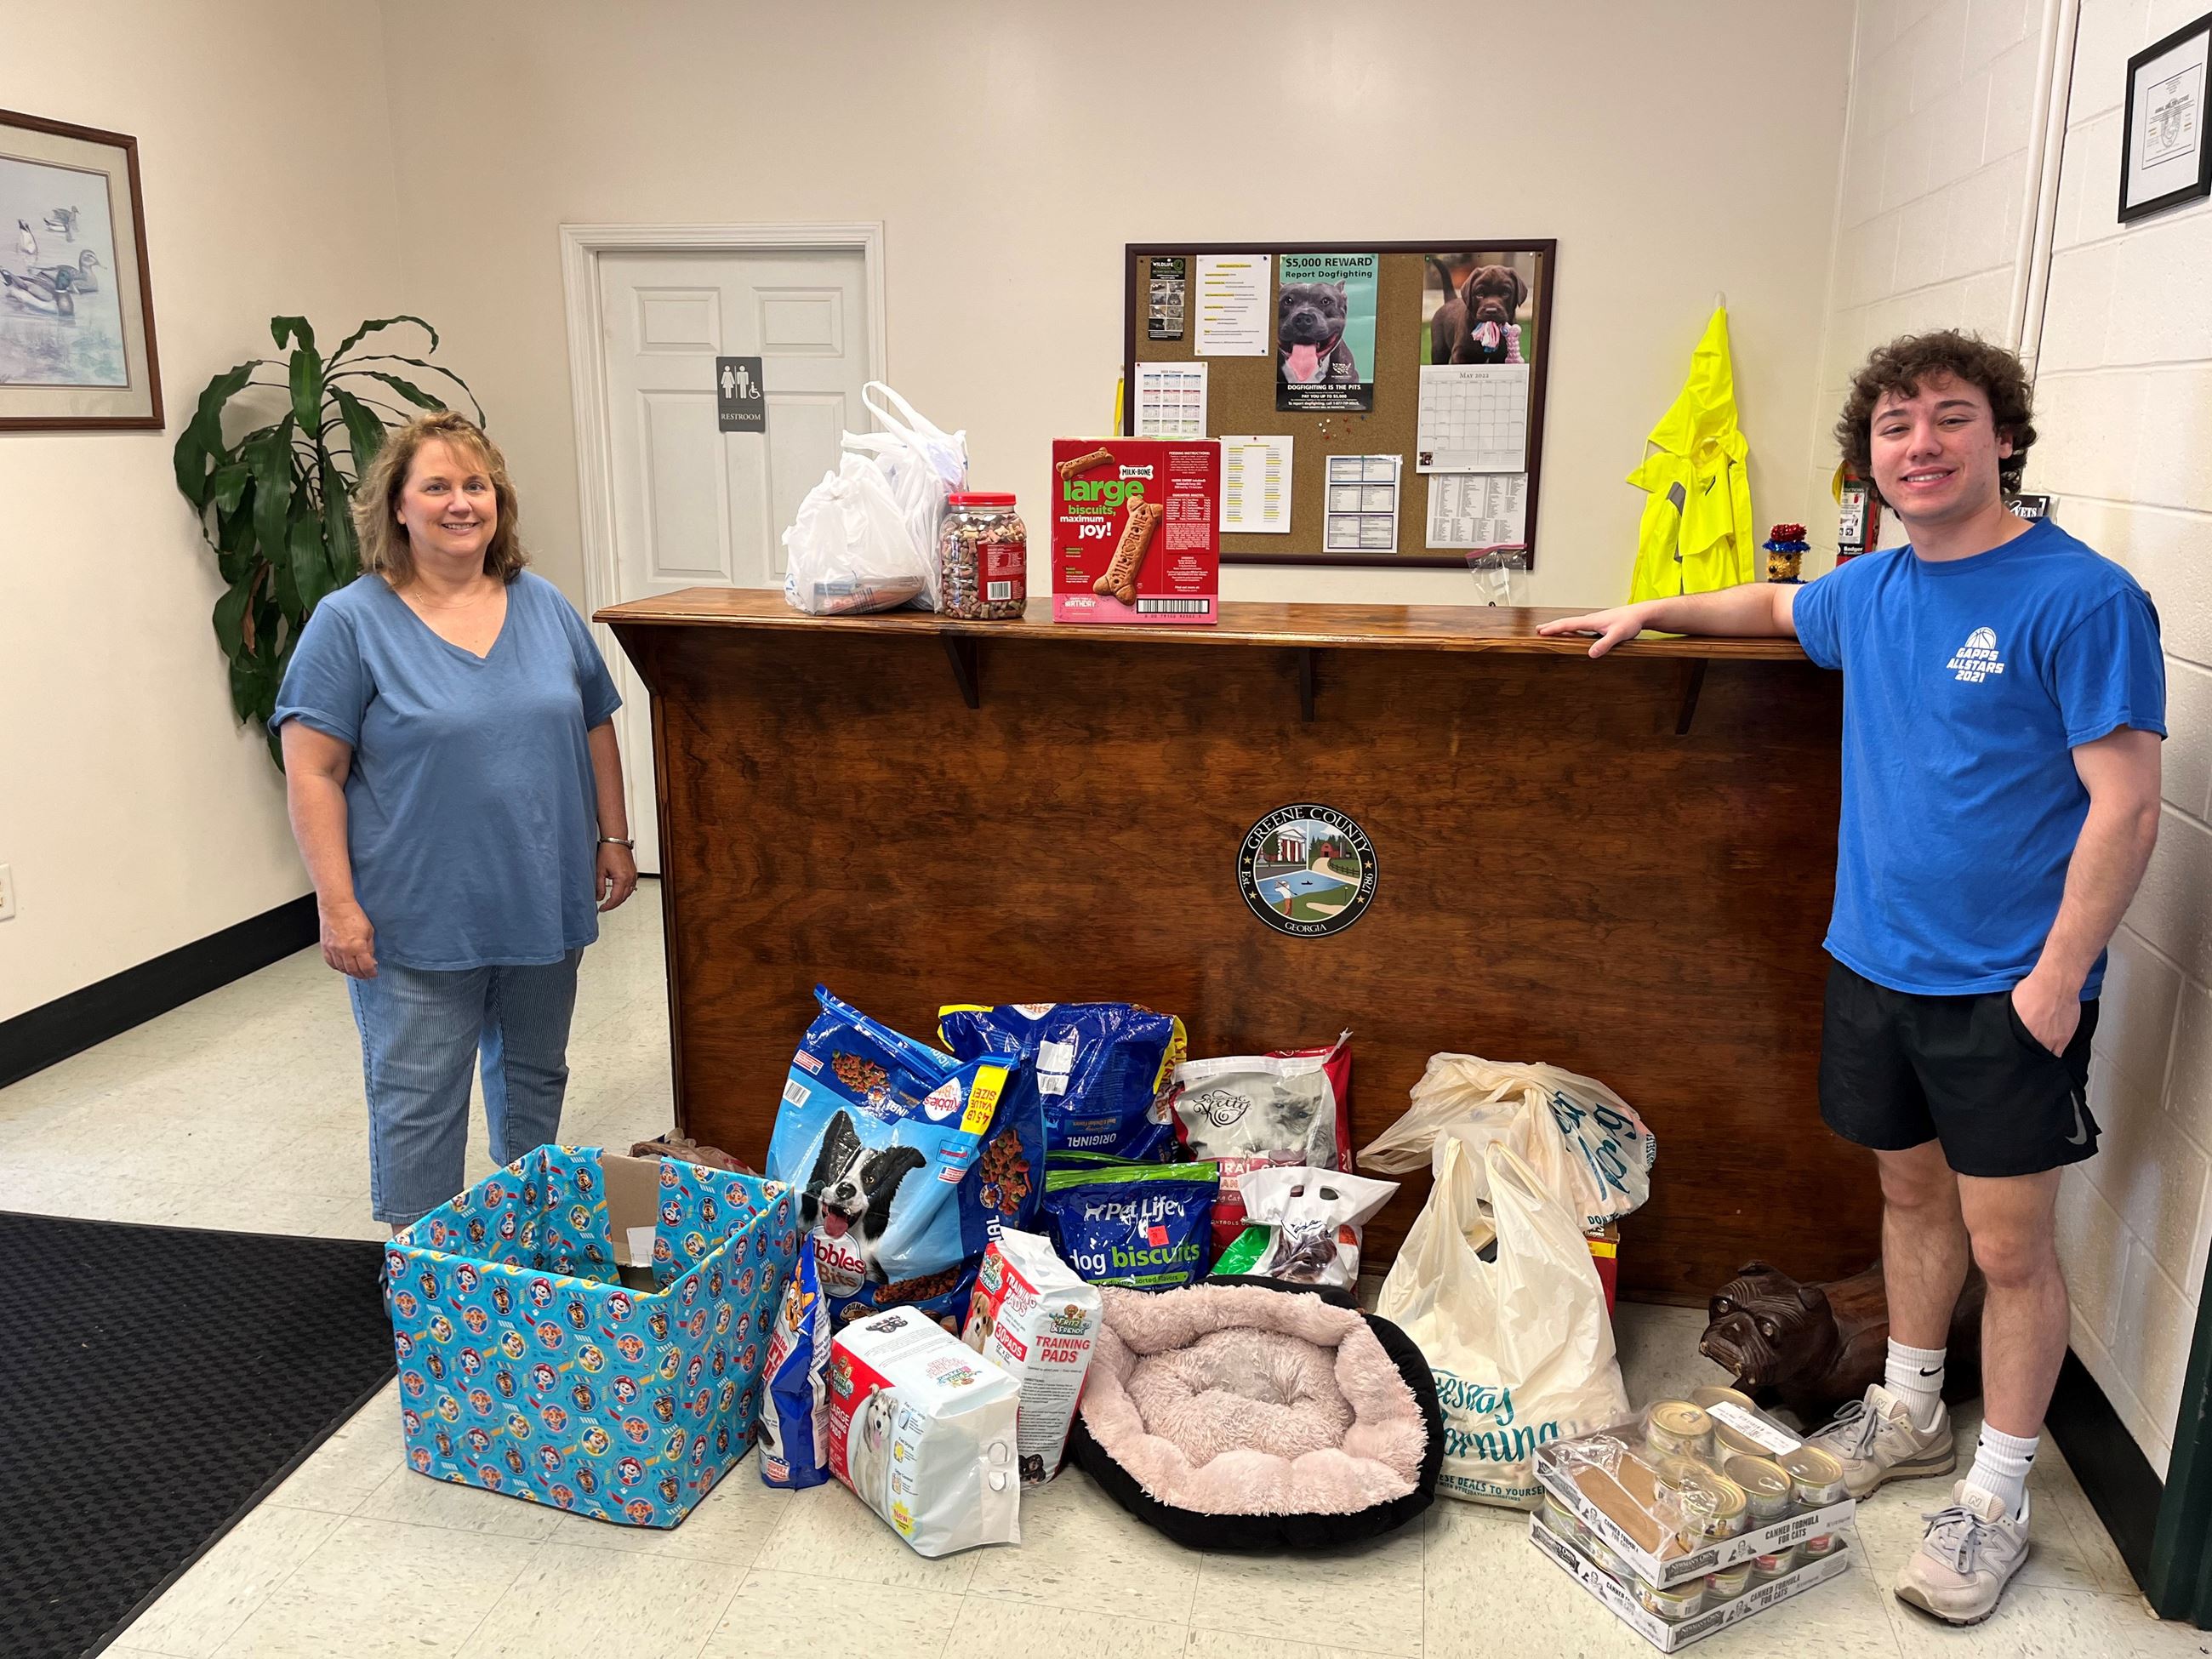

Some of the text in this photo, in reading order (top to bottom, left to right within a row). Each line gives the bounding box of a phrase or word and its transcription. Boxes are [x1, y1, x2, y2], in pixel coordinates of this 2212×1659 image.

[1286, 257, 1373, 268] $5,000 REWARD
[1286, 270, 1373, 279] Report Dogfighting
[1063, 479, 1144, 506] large
[1068, 505, 1117, 516] biscuits,
[1078, 522, 1112, 539] joy!
[1956, 647, 1999, 661] GAPPS
[1946, 658, 2005, 674] ALLSTARS
[1954, 670, 1986, 683] 2021
[1247, 807, 1371, 852] GREENE COUNTY
[1241, 870, 1251, 888] Est.
[1361, 872, 1374, 894] 1786
[1285, 921, 1327, 932] GEORGIA
[973, 1088, 997, 1101] SIZE!
[924, 1094, 961, 1113] Kibbles
[970, 1098, 994, 1111] VALUE
[1067, 1132, 1117, 1147] ORIGINAL
[1104, 1200, 1137, 1221] Pet
[1111, 1240, 1200, 1268] biscuits
[817, 1263, 858, 1287] Bits
[1158, 1274, 1178, 1283] Flavors
[1006, 1272, 1037, 1308] TRAINING
[1004, 1287, 1028, 1318] PADS
[1050, 1322, 1058, 1333] &
[1058, 1318, 1080, 1326] FRITZ
[1035, 1335, 1092, 1350] TRAINING
[1040, 1348, 1079, 1363] PADS
[1457, 1476, 1487, 1492] DEALS
[1490, 1485, 1502, 1495] TO
[893, 1508, 908, 1523] New
[1604, 1519, 1621, 1536] CANNED
[1764, 1523, 1791, 1540] CANNED
[1791, 1514, 1820, 1531] FORMULA
[1777, 1528, 1807, 1545] FOR CATS
[1606, 1582, 1625, 1599] CANNED
[1750, 1574, 1800, 1603] CANNED FORMULA
[1760, 1588, 1787, 1605] FOR CATS
